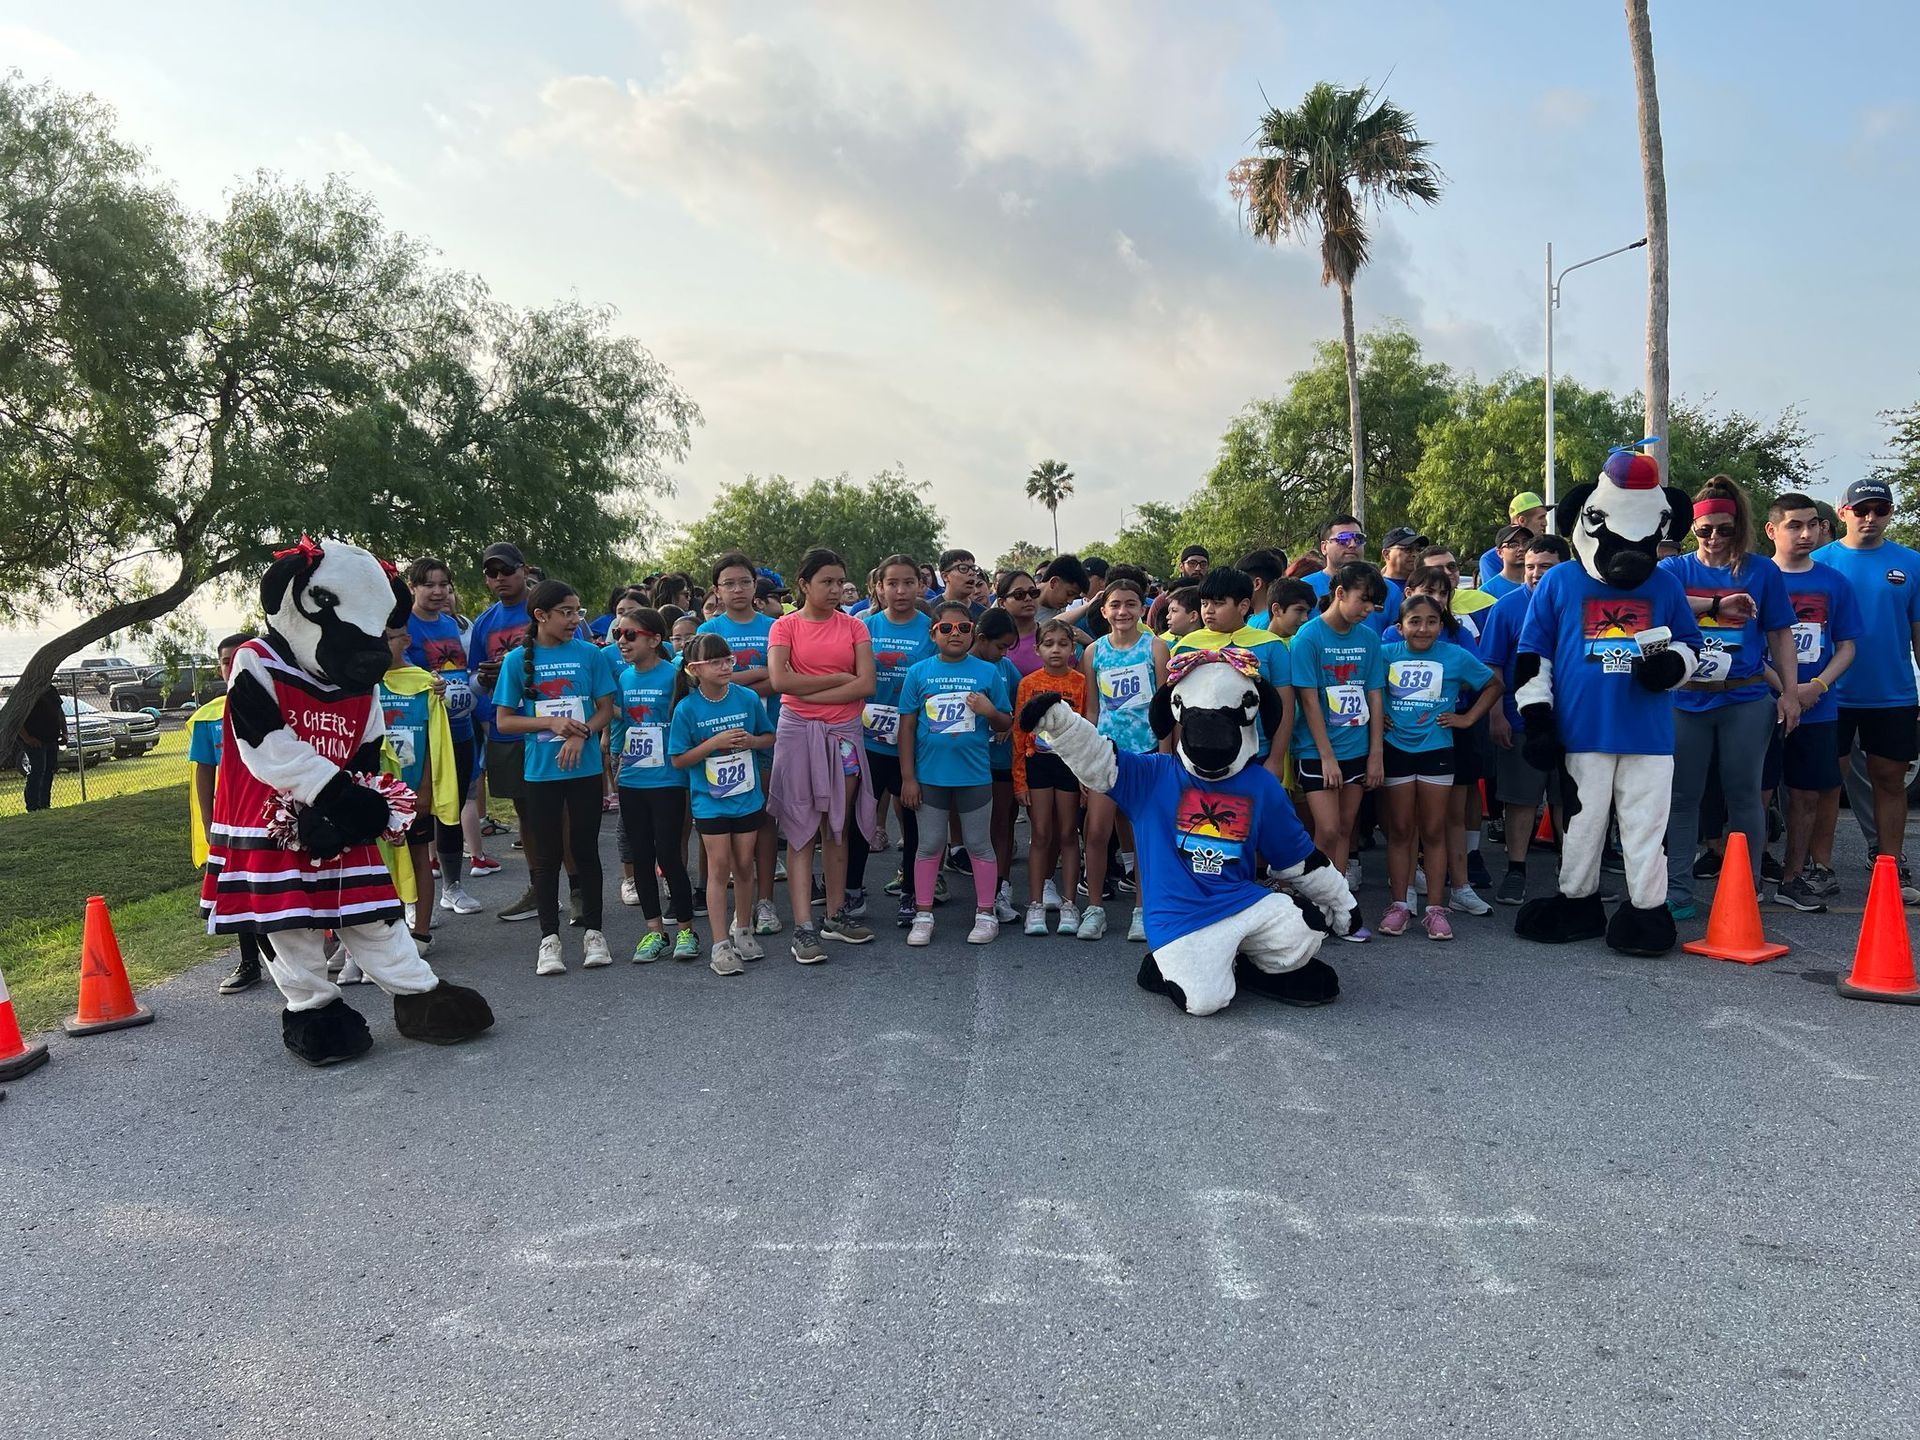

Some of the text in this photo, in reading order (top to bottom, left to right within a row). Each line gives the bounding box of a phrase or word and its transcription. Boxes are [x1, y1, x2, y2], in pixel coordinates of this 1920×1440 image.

[948, 677, 977, 685] ANYTHING
[1111, 675, 1141, 698] 766
[1399, 670, 1433, 688] 839
[451, 693, 472, 709] 648
[1340, 696, 1362, 714] 732
[288, 709, 298, 727] 3
[937, 702, 966, 721] 762
[869, 713, 897, 733] 775
[629, 738, 653, 756] 656
[717, 762, 747, 787] 828
